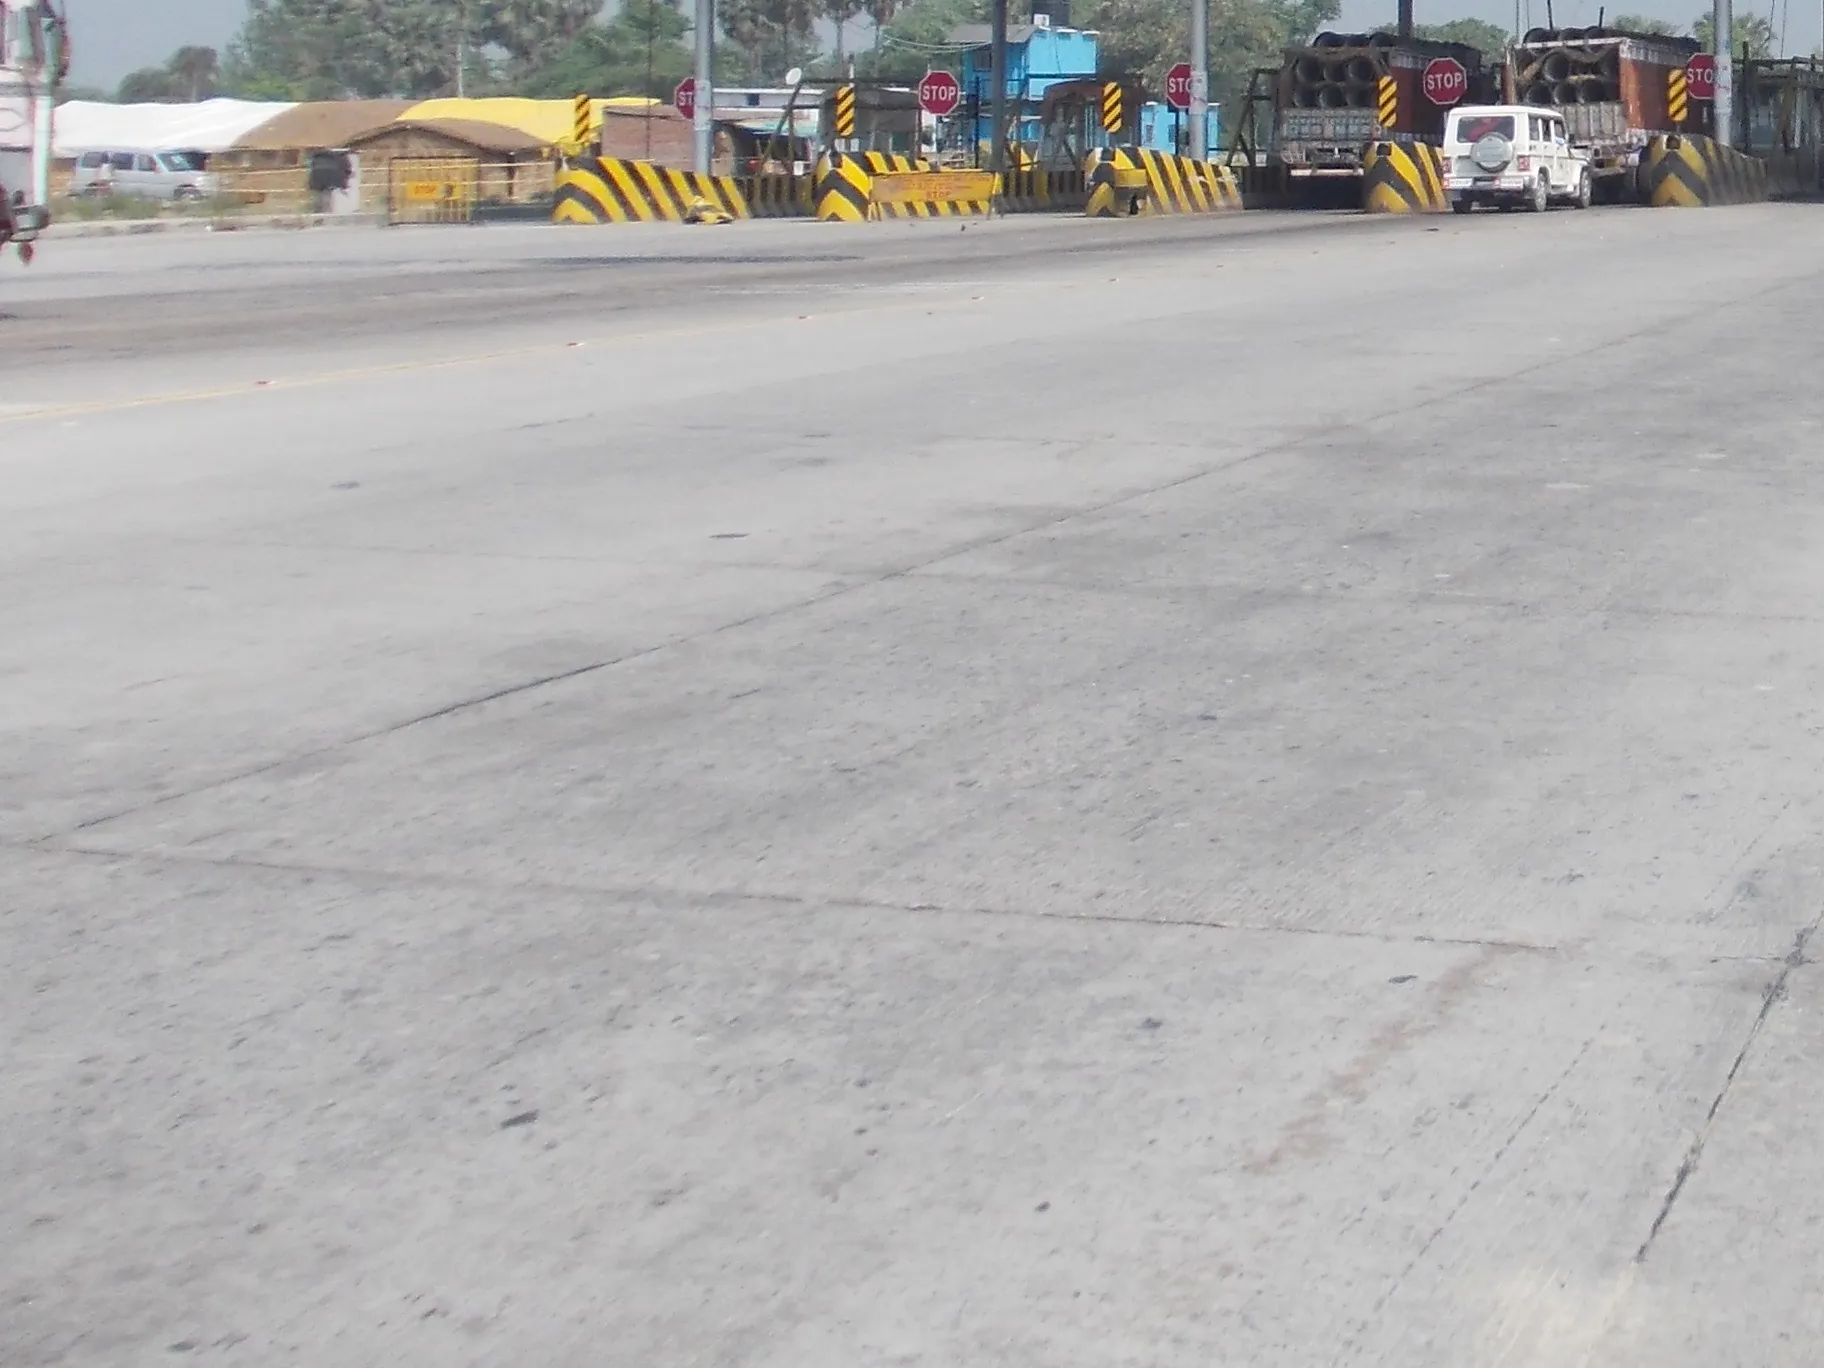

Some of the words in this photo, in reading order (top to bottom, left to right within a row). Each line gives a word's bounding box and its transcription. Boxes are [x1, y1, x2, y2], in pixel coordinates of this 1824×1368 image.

[1427, 72, 1462, 90] STOP
[1686, 68, 1713, 83] STO
[679, 91, 693, 106] ST
[922, 85, 956, 101] STOP
